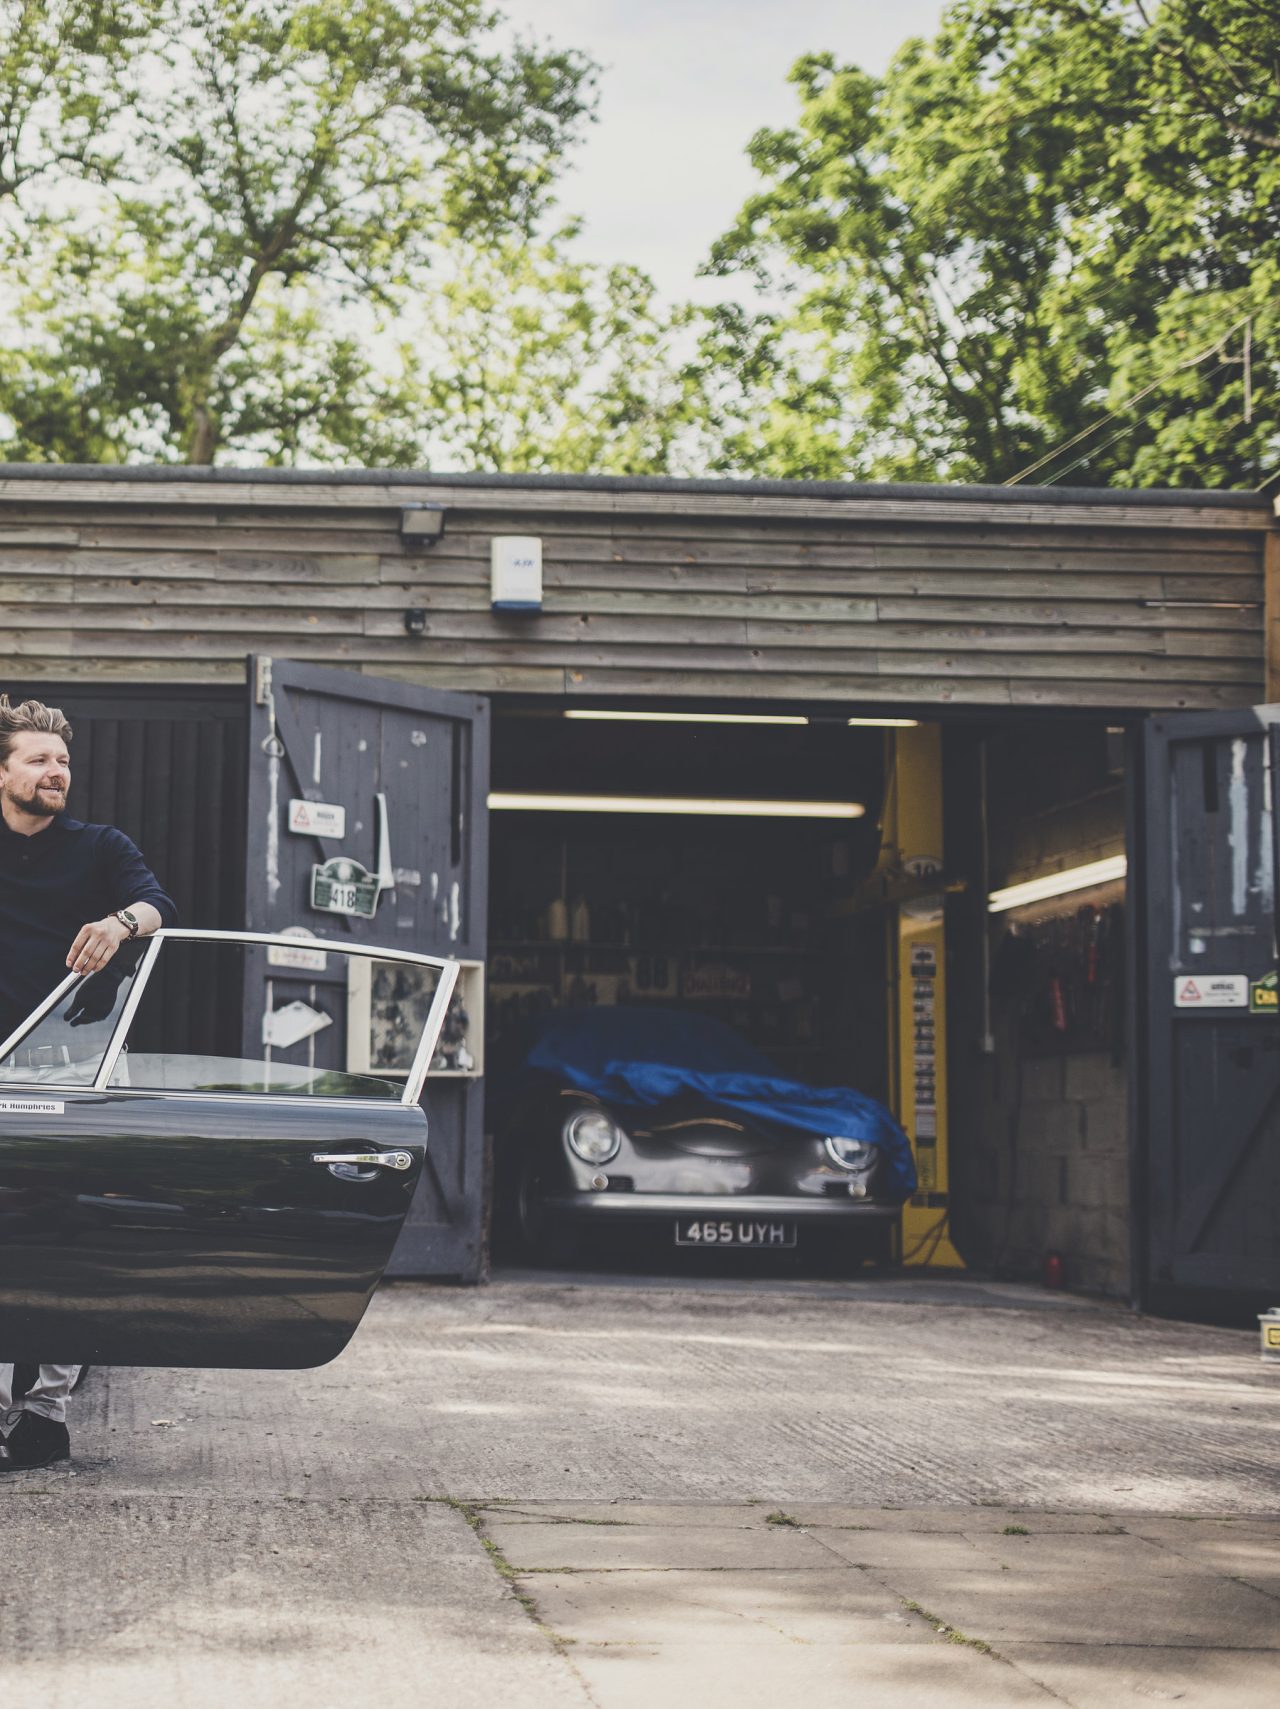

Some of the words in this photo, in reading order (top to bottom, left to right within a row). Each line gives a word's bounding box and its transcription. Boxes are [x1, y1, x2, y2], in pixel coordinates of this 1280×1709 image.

[331, 889, 356, 908] 418
[9, 1103, 56, 1111] Humphries
[687, 1221, 733, 1243] 465
[738, 1222, 784, 1245] UYH
